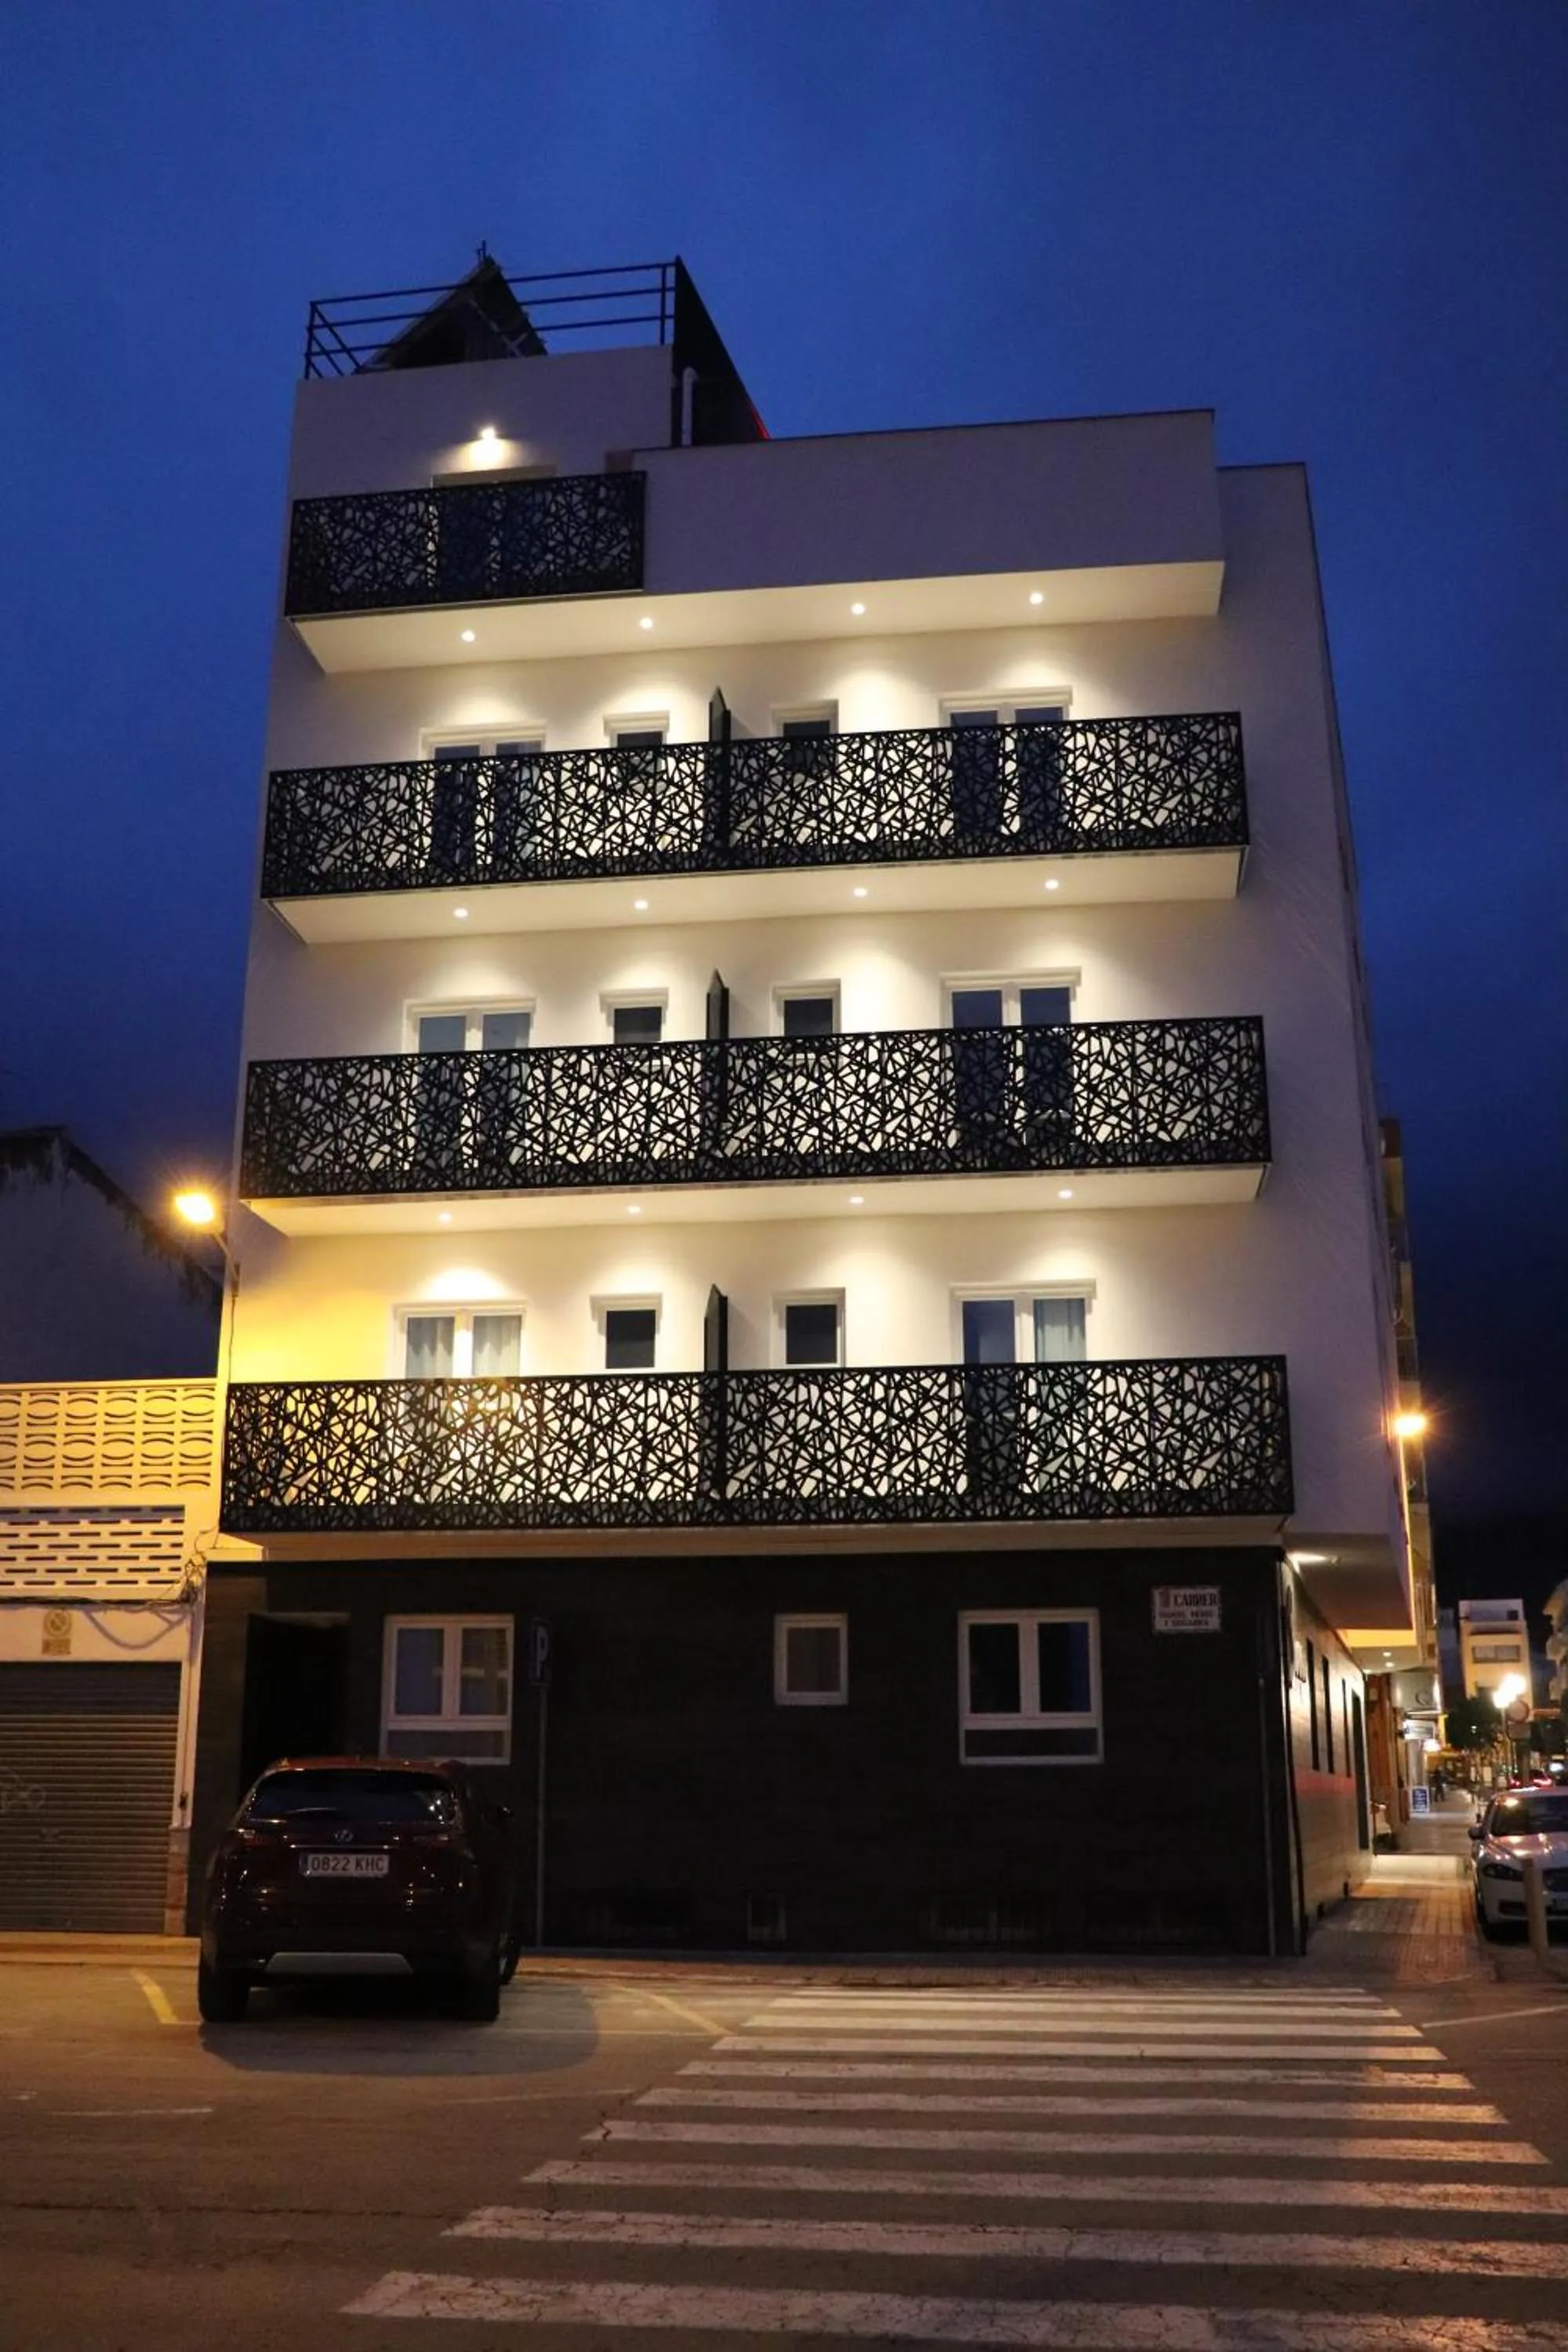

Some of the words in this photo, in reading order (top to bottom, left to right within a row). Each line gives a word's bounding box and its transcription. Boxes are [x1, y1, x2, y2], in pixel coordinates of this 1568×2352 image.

[1174, 1592, 1218, 1606] CARRER
[535, 1624, 550, 1679] P
[354, 1856, 385, 1871] KHC
